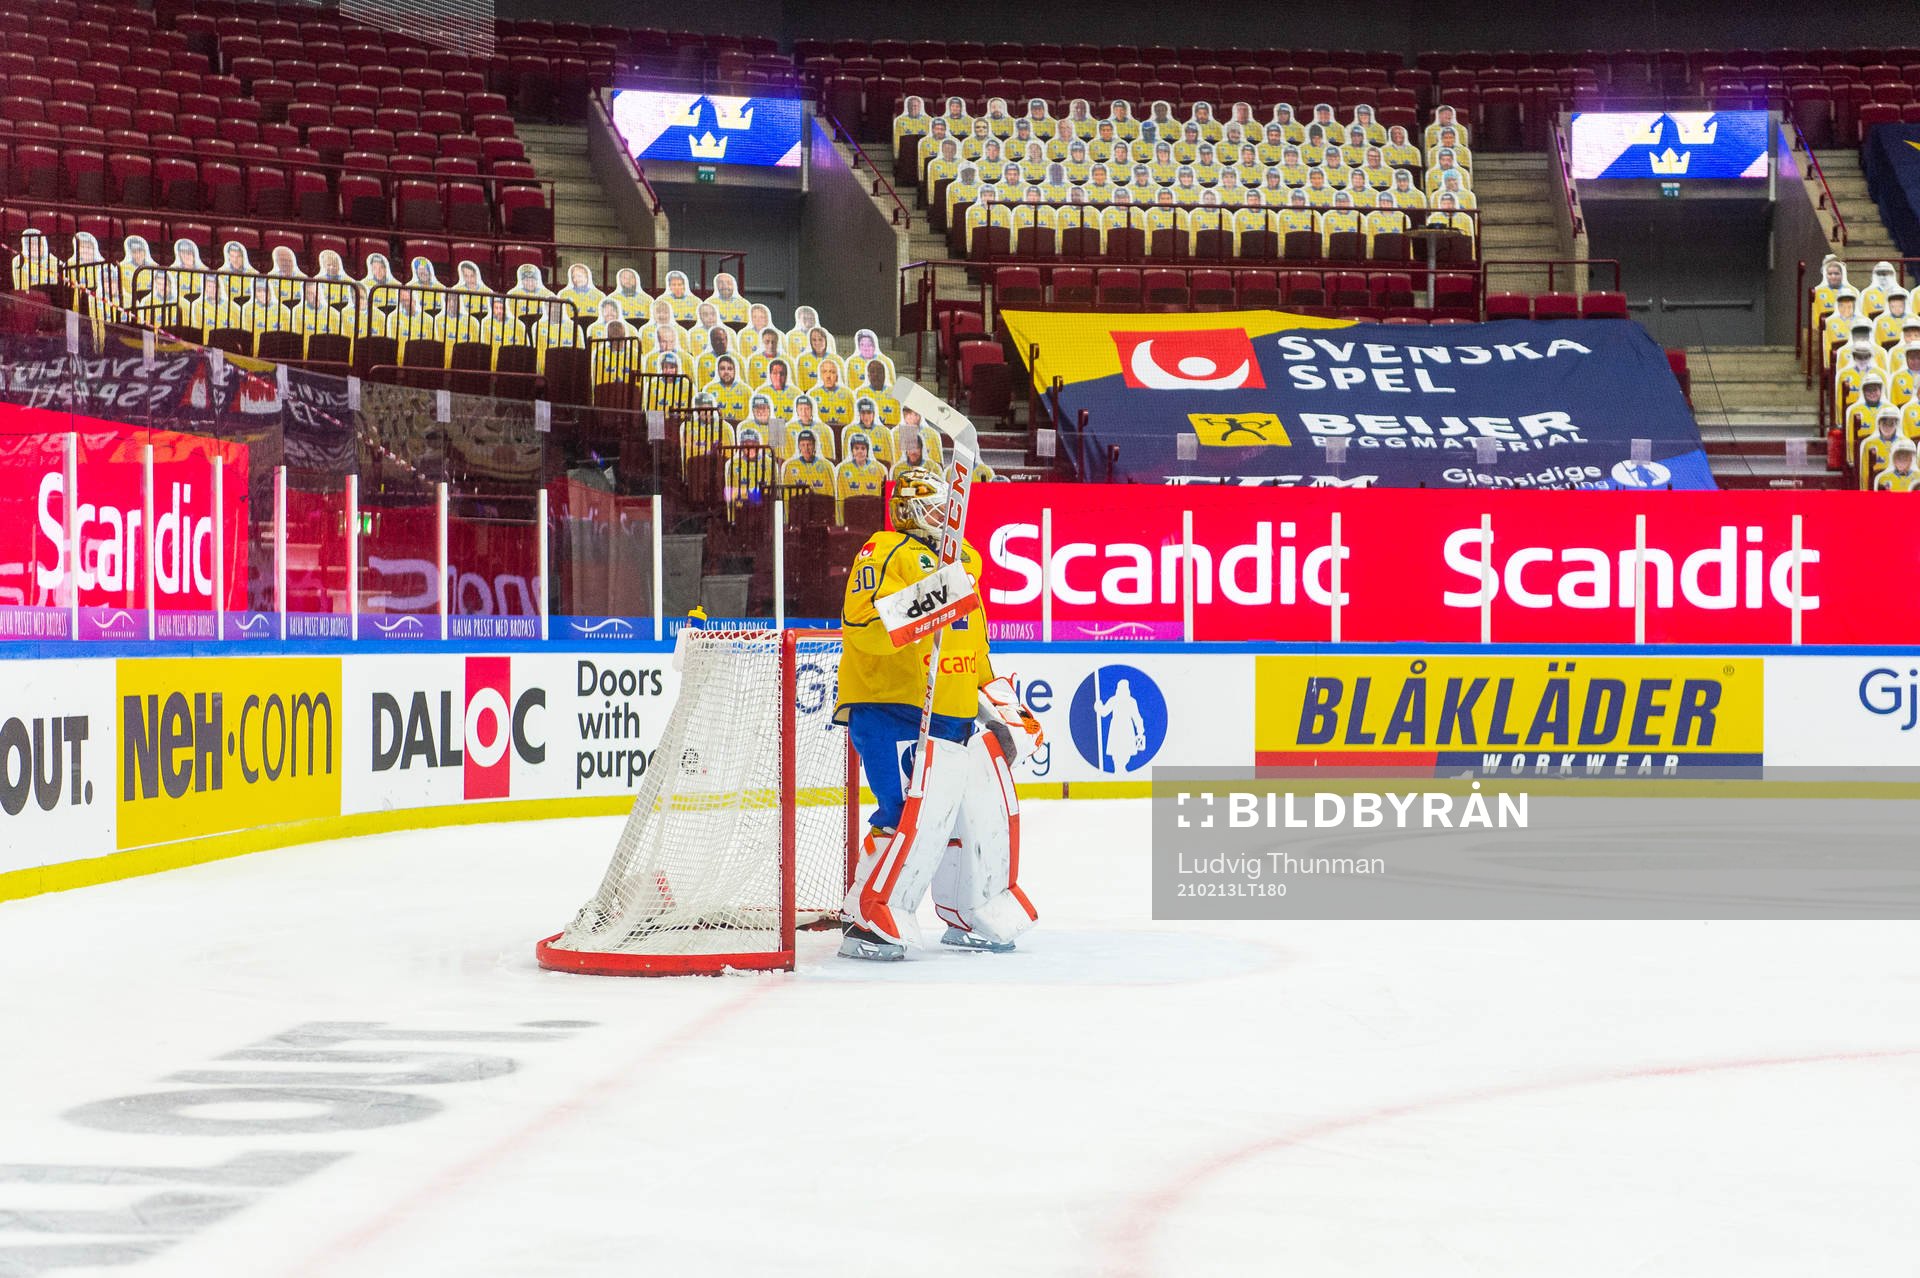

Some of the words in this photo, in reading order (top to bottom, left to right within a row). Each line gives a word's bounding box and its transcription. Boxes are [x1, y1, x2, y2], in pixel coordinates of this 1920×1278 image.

[1277, 336, 1593, 365] SVENSKA
[1288, 365, 1457, 393] SPEL
[1299, 411, 1580, 440] BEIJER
[1311, 431, 1588, 453] BYGGMATERIAL
[941, 459, 969, 566] CCM
[989, 521, 1350, 606] Scandic
[1443, 525, 1820, 610] Scandic
[906, 585, 948, 619] APP
[452, 618, 471, 637] HALVA
[473, 618, 493, 637] PRISET
[495, 618, 508, 637] MED
[510, 618, 535, 638] BROPASS
[1001, 623, 1034, 640] BROPASS
[577, 660, 663, 697] Doors
[578, 700, 640, 740] with
[1296, 660, 1723, 746] BLÅKLÄDER
[371, 687, 546, 773] DALOC
[0, 715, 93, 816] OUT.
[577, 748, 656, 790] purp
[1482, 753, 1681, 776] WORKWEAR
